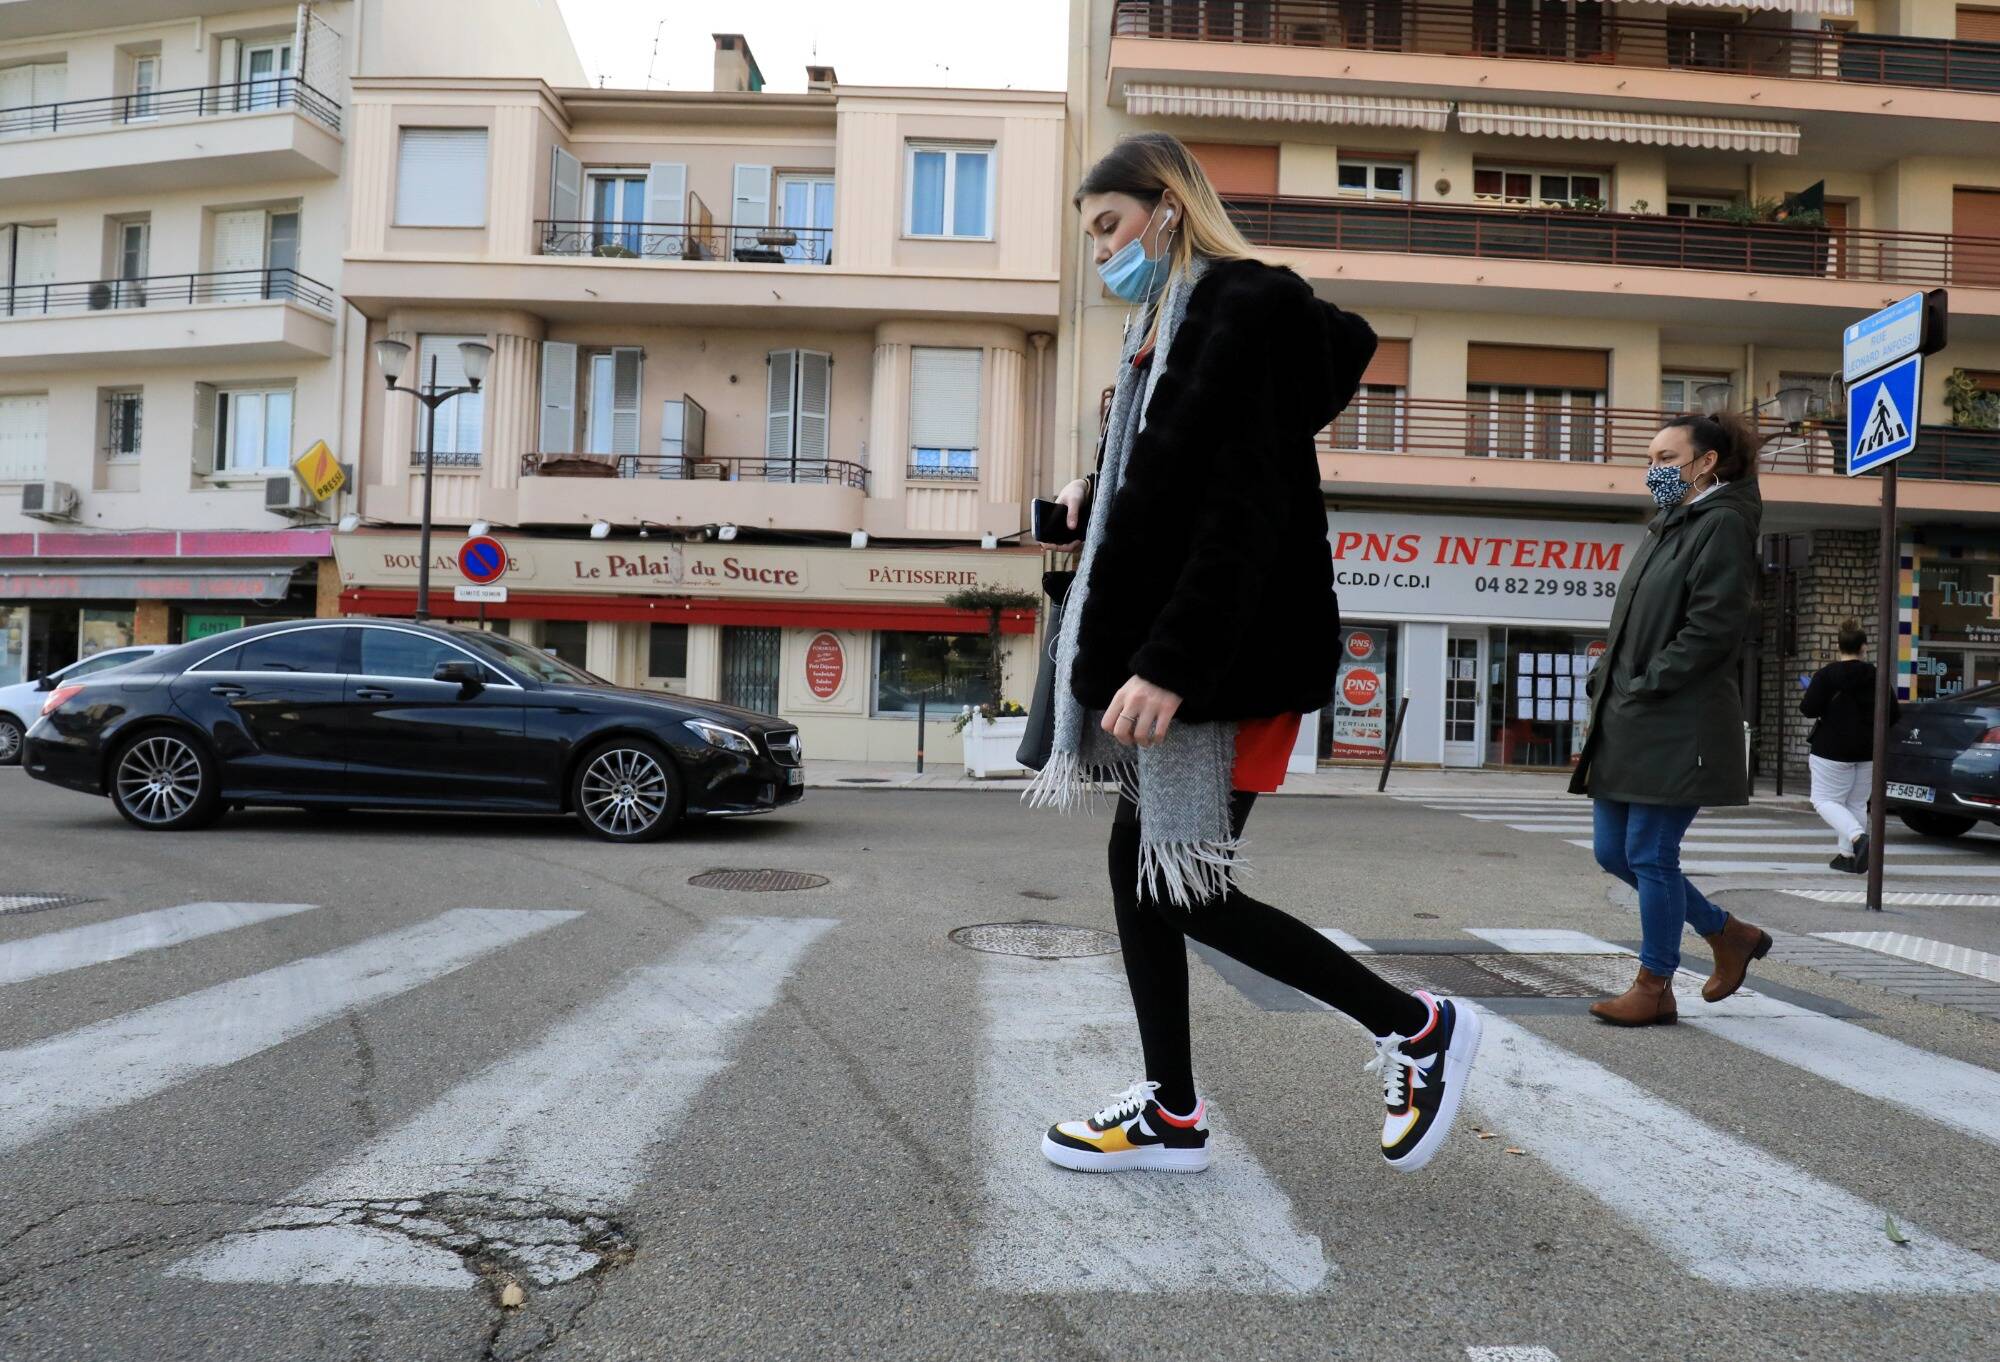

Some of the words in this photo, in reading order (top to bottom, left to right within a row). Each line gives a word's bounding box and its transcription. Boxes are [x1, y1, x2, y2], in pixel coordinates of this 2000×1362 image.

[1871, 333, 1888, 344] RUE
[1332, 532, 1422, 563] PNS
[1433, 536, 1625, 571] INTERIM
[384, 554, 519, 571] BOUANE
[574, 560, 600, 578] Le
[606, 555, 670, 577] Palai
[691, 561, 716, 576] du
[723, 557, 800, 585] Sucre
[869, 565, 978, 585] PÂTISSERIE
[1336, 571, 1380, 586] C.D.D
[1393, 574, 1430, 589] C.D.I
[1475, 576, 1500, 593] 04
[1504, 577, 1529, 594] 82
[1534, 578, 1558, 595] 29
[1563, 579, 1588, 596] 98
[1592, 581, 1617, 598] 38
[1350, 638, 1370, 647] PNS
[1915, 656, 1948, 675] Elle
[1345, 679, 1377, 691] PNS
